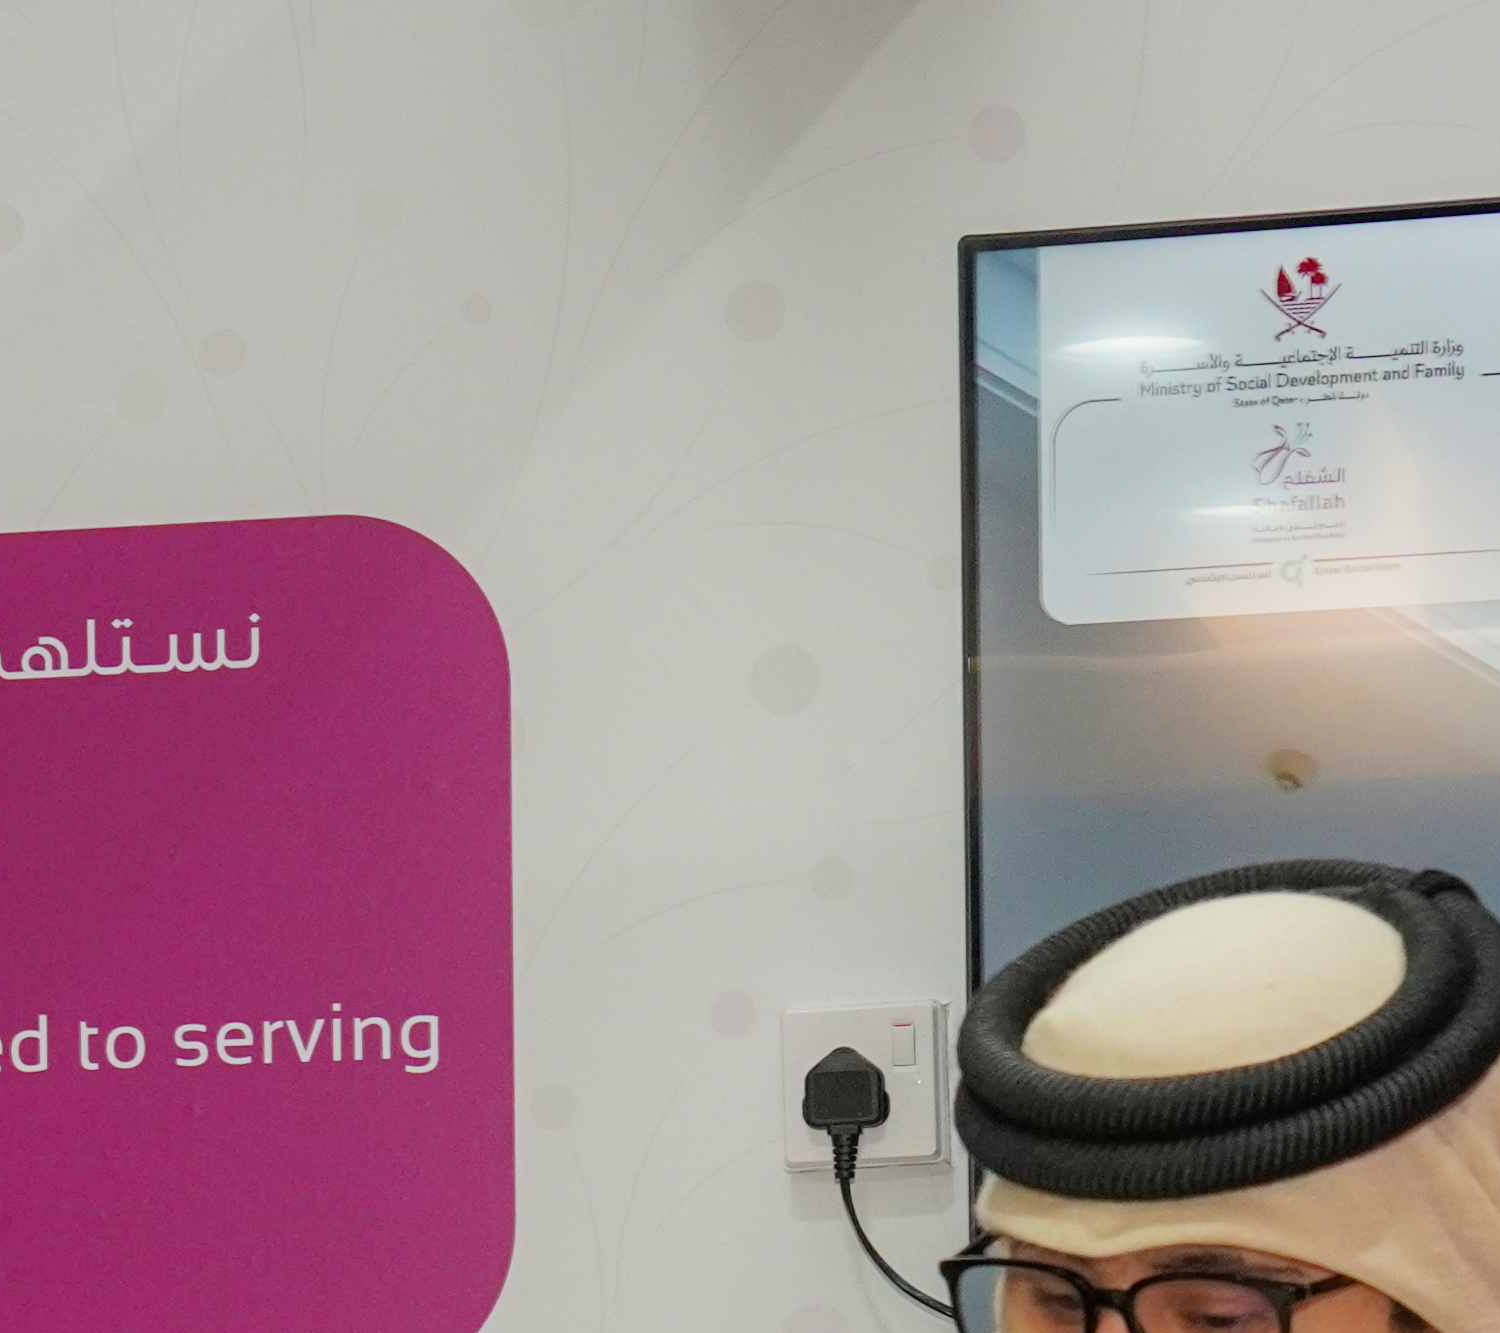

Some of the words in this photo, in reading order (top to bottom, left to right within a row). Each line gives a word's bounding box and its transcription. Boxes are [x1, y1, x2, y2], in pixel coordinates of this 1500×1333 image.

[1140, 380, 1203, 400] Ministry
[1206, 377, 1222, 395] of
[1226, 374, 1274, 393] Social
[1276, 368, 1379, 391] Development
[1382, 364, 1411, 382] and
[1414, 361, 1466, 381] Family
[80, 1021, 145, 1070] to
[175, 1003, 439, 1073] serving
